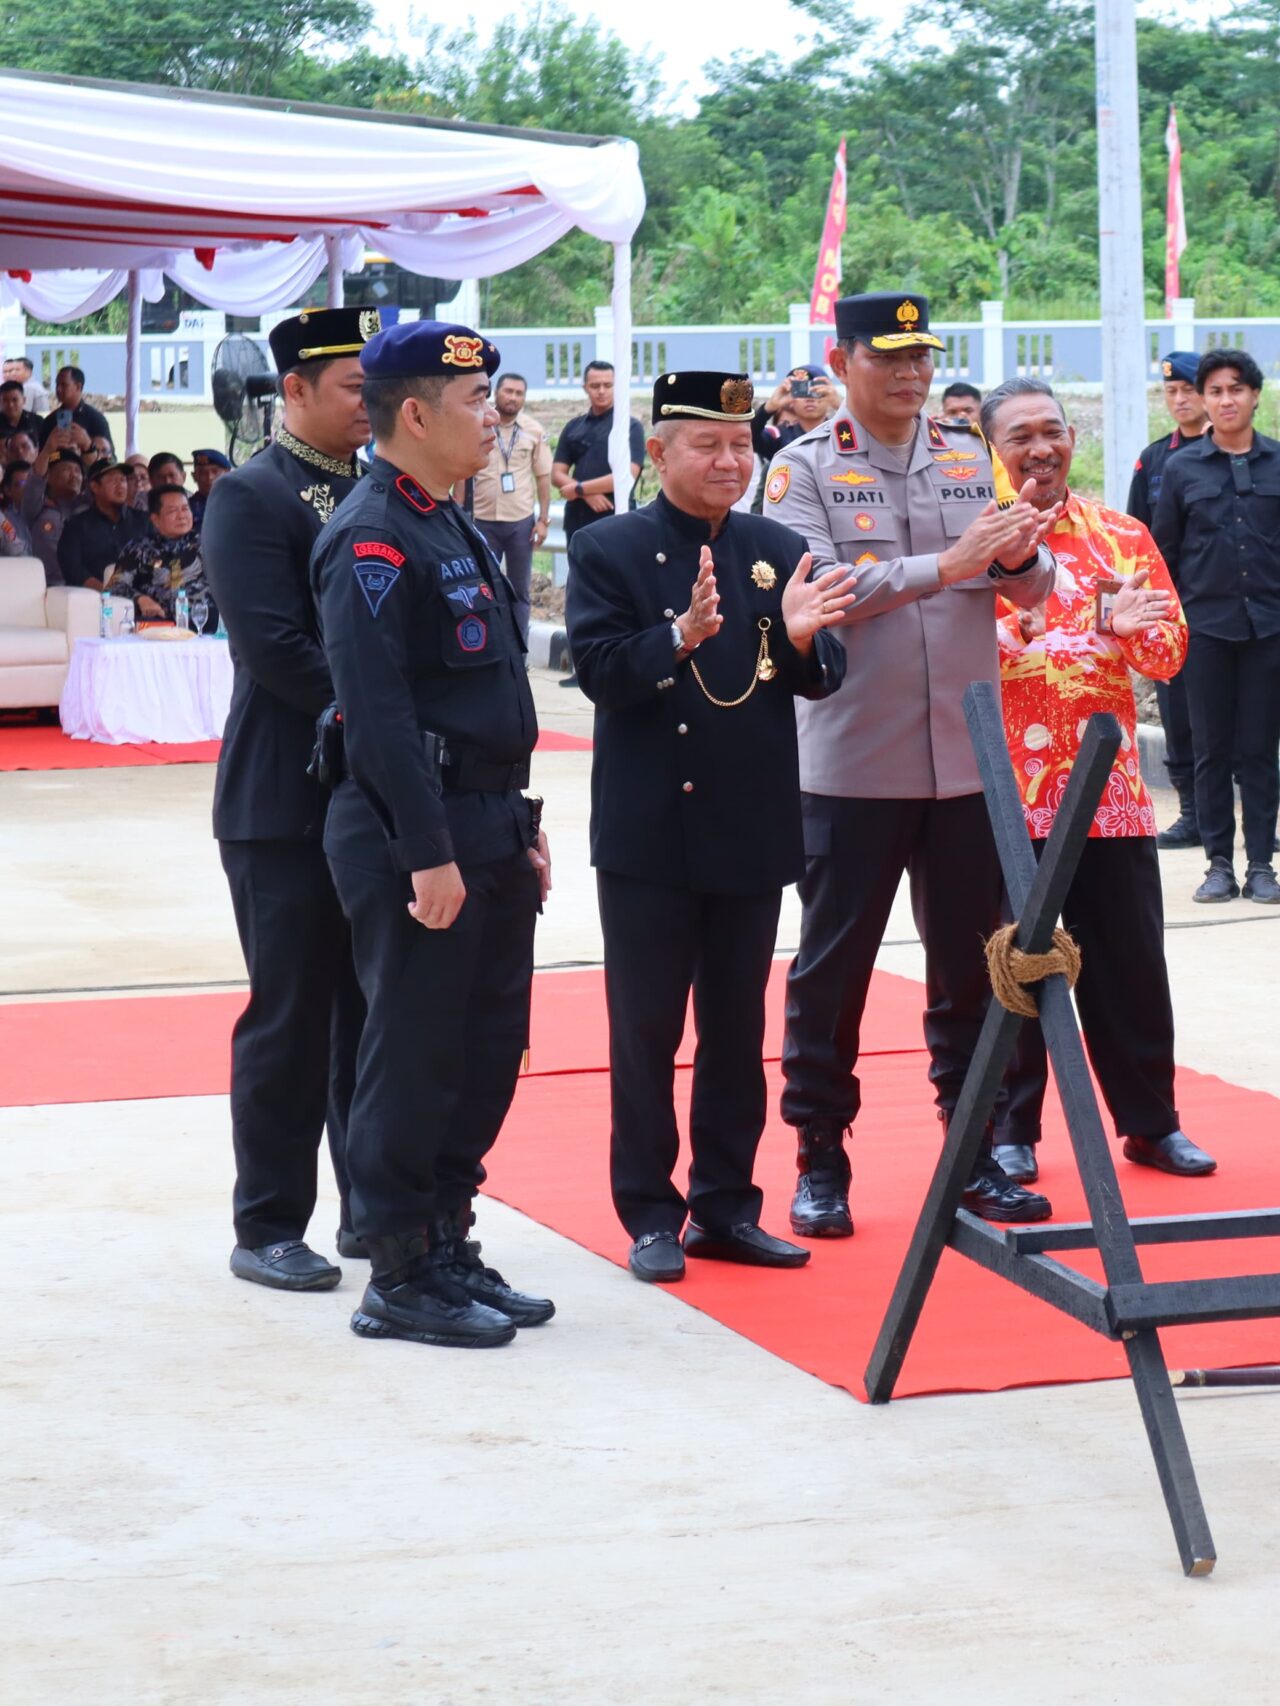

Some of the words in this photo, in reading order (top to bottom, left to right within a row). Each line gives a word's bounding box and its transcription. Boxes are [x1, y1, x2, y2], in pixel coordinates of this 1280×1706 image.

[832, 491, 884, 504] DJATI
[941, 486, 994, 500] POLRI
[358, 545, 401, 563] GEGANA
[440, 557, 477, 580] ARIF
